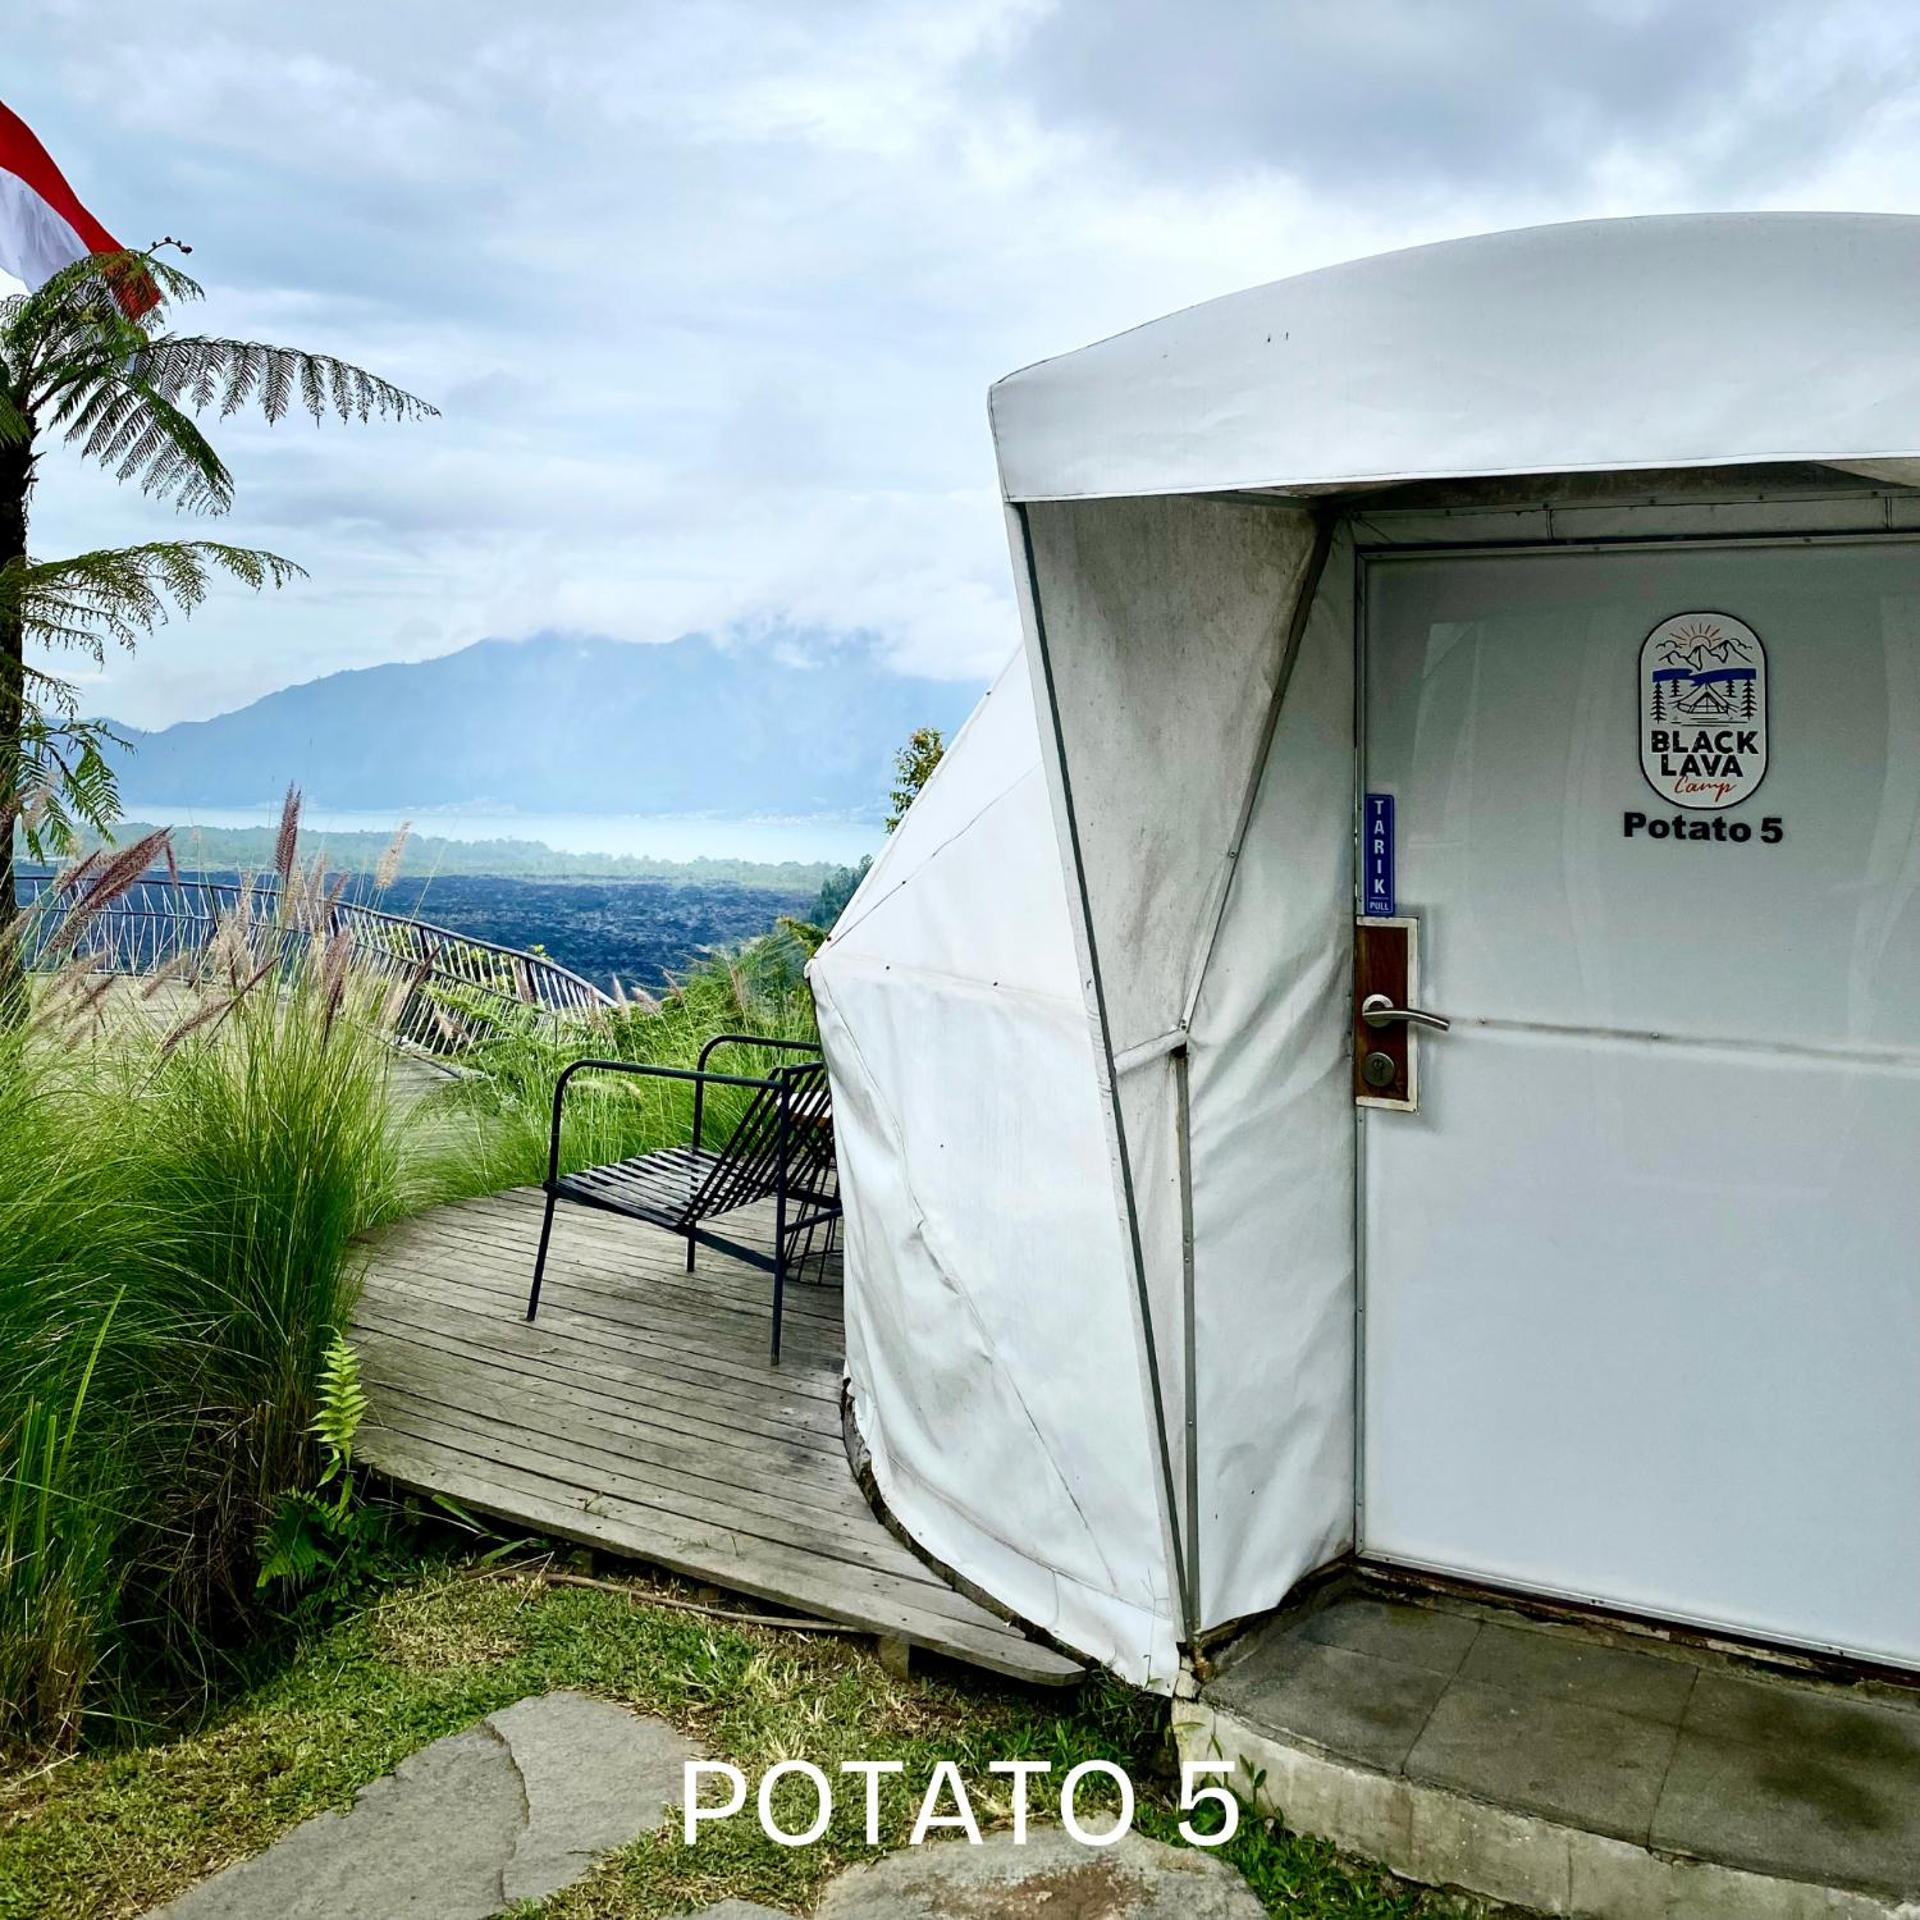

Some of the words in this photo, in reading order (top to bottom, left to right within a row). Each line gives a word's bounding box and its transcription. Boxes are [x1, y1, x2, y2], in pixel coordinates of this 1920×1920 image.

[1651, 730, 1759, 754] BLACK
[1660, 754, 1743, 777] LAVA
[1674, 775, 1736, 802] Camp
[1623, 812, 1752, 843] Potato
[1760, 817, 1784, 843] 5
[1373, 800, 1386, 894] TARIK
[1369, 901, 1390, 911] PULL
